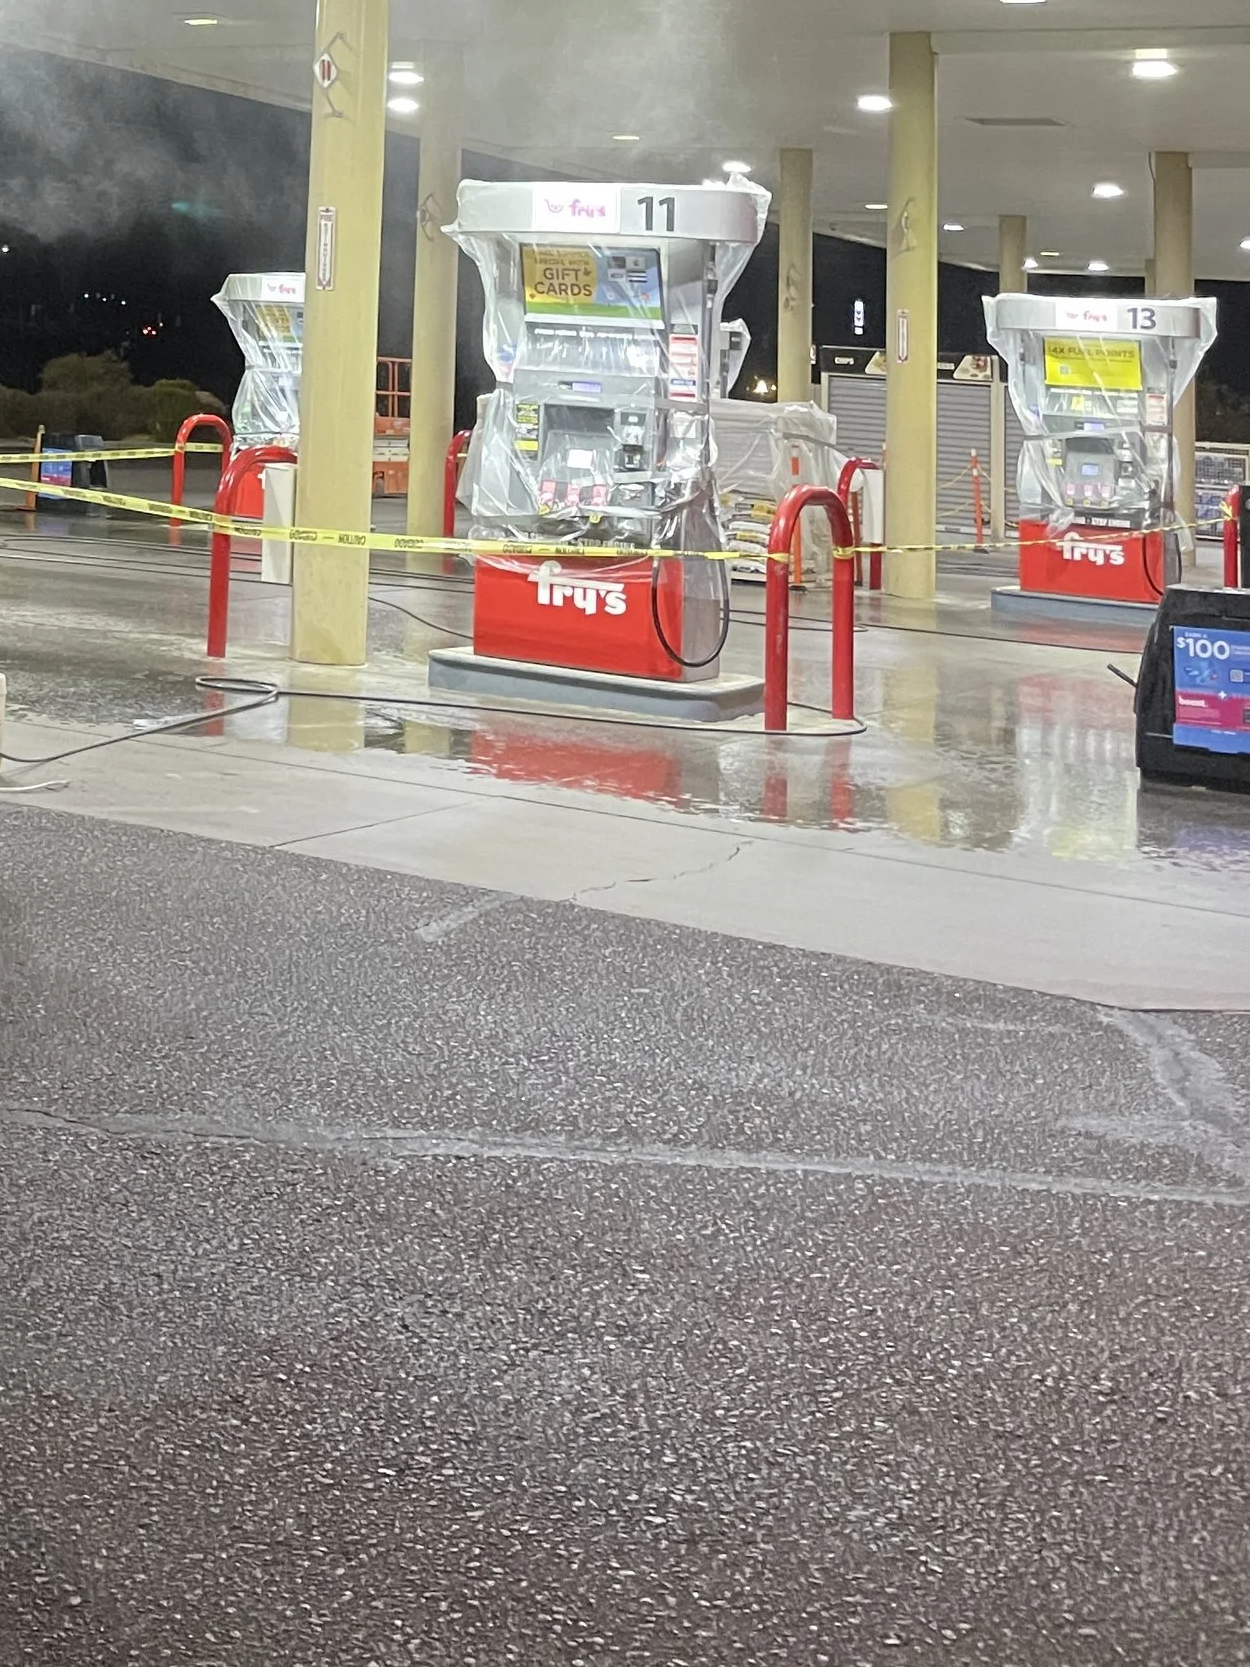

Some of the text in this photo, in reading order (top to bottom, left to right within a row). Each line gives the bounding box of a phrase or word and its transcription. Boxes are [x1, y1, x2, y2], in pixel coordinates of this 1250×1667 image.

[637, 196, 675, 232] 11
[543, 267, 582, 281] GIFT
[534, 281, 593, 297] CARDS
[1127, 307, 1157, 330] 13
[338, 533, 367, 546] CAUTION
[1056, 531, 1125, 566] fry's
[527, 560, 627, 615] fry's
[1177, 637, 1231, 660] $100
